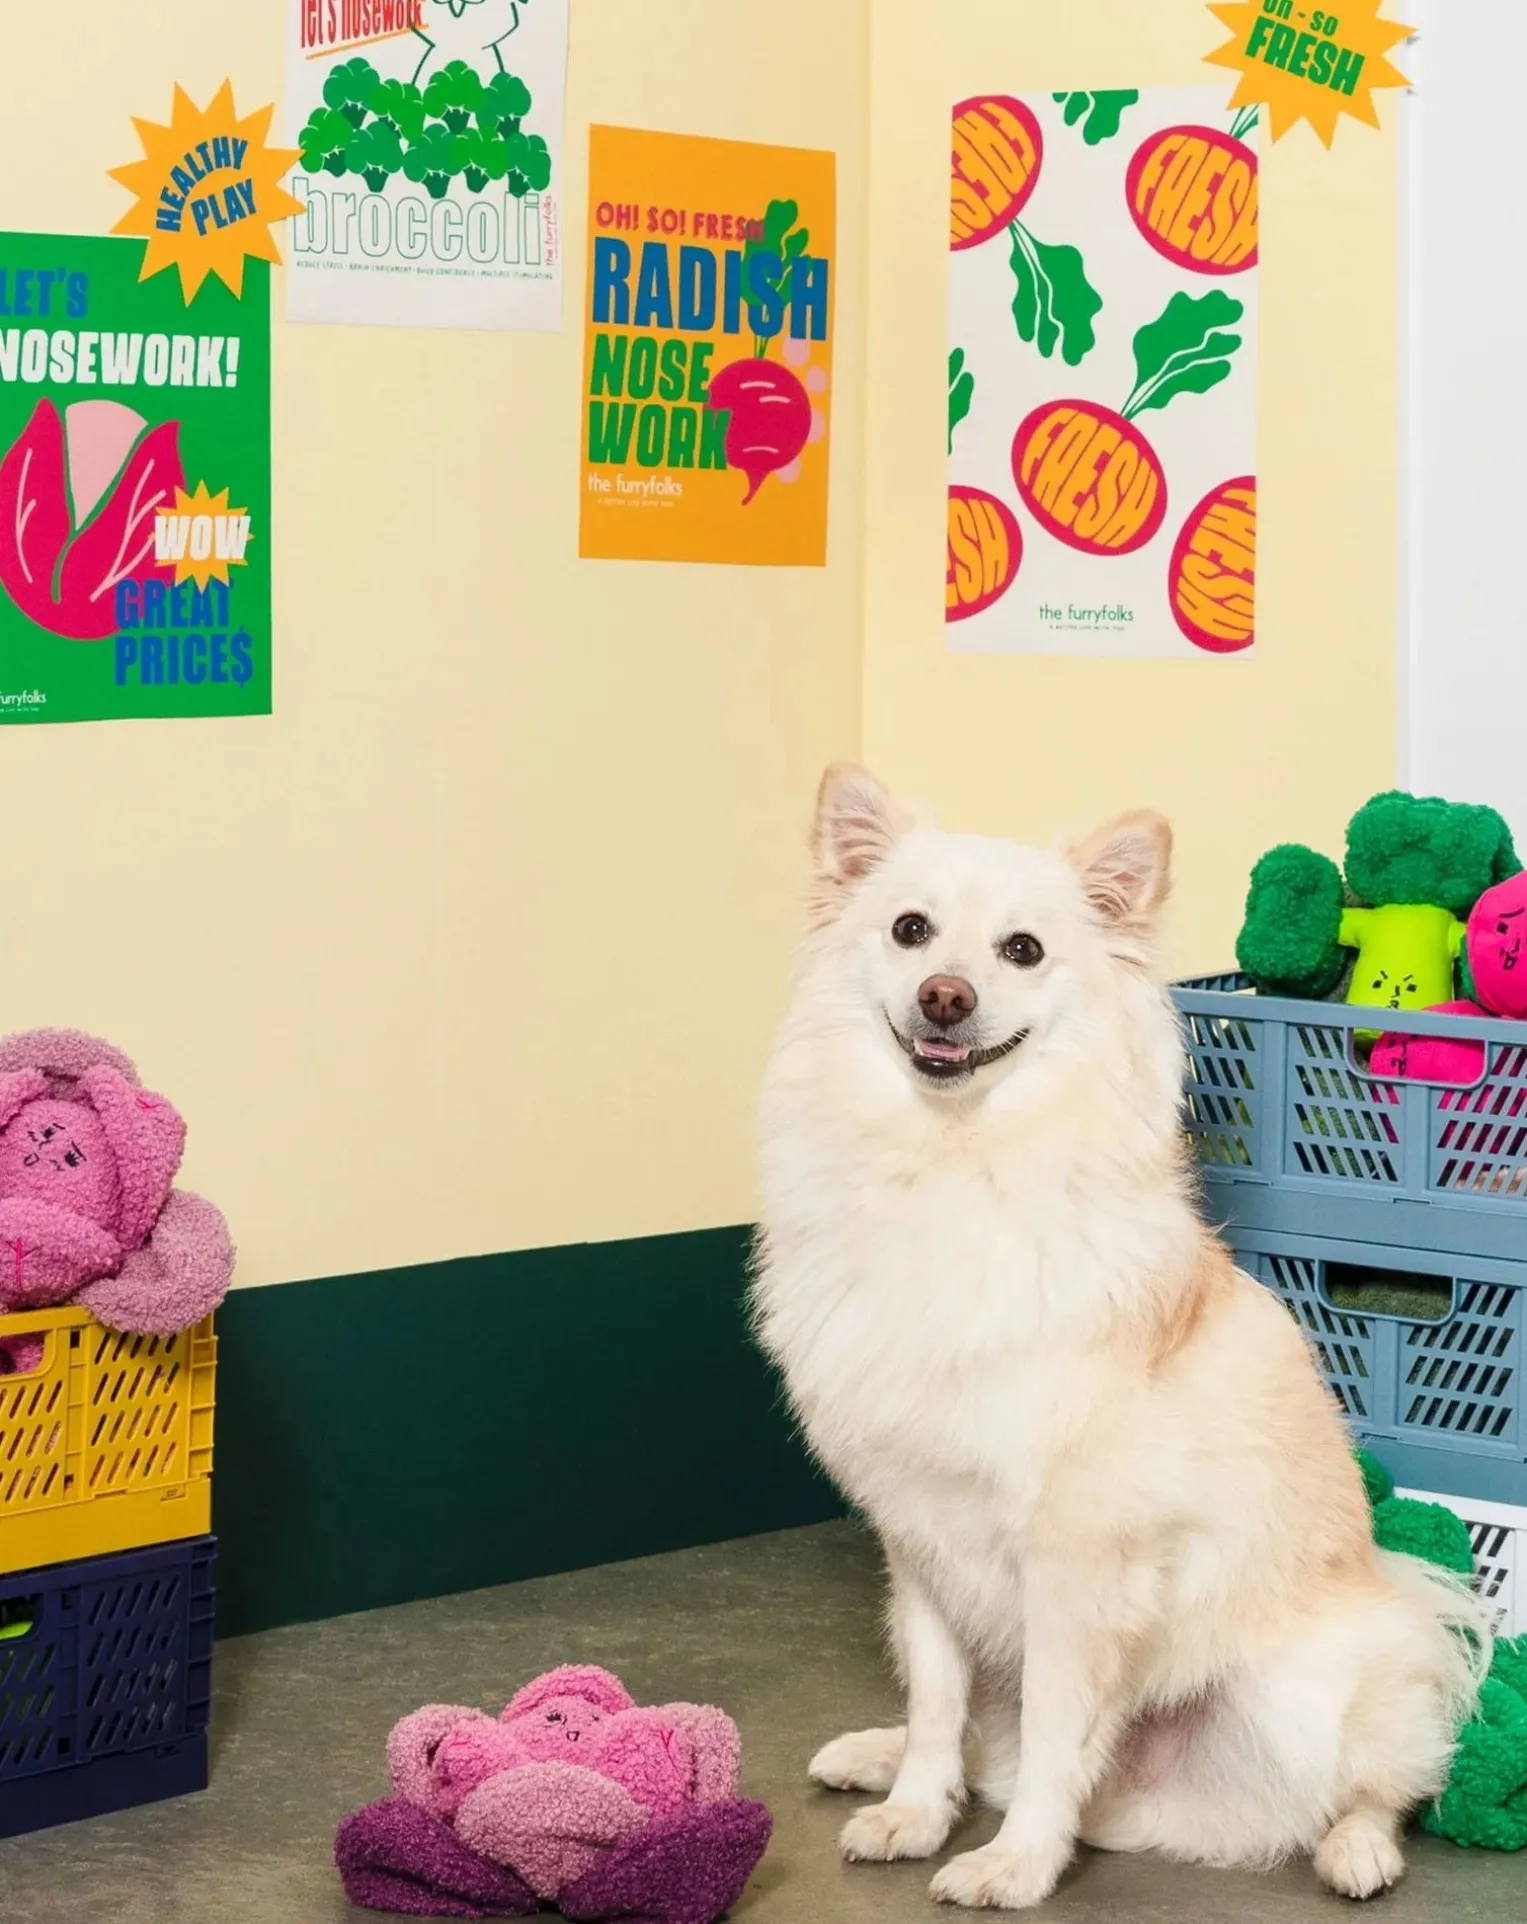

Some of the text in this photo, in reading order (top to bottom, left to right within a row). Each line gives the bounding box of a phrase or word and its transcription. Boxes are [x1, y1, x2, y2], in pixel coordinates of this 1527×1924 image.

[1245, 15, 1365, 96] FRESH
[156, 136, 248, 232] HEALTHY
[190, 178, 256, 236] PLAY
[293, 177, 541, 265] broccoli
[596, 201, 764, 243] OH! SO! FRESH
[0, 267, 88, 319] LET'S
[592, 236, 828, 341] RADISH
[0, 328, 241, 388] NOSEWORK!
[590, 333, 714, 403] NOSE
[588, 400, 733, 470] WORK
[588, 472, 683, 499] the furryfolks
[1020, 407, 1158, 548] FRESH
[154, 515, 251, 561] WOW
[115, 579, 234, 629] GREAT
[1039, 602, 1134, 624] the furryfolks
[115, 625, 253, 689] PRICE$
[0, 689, 47, 707] urryfolks
